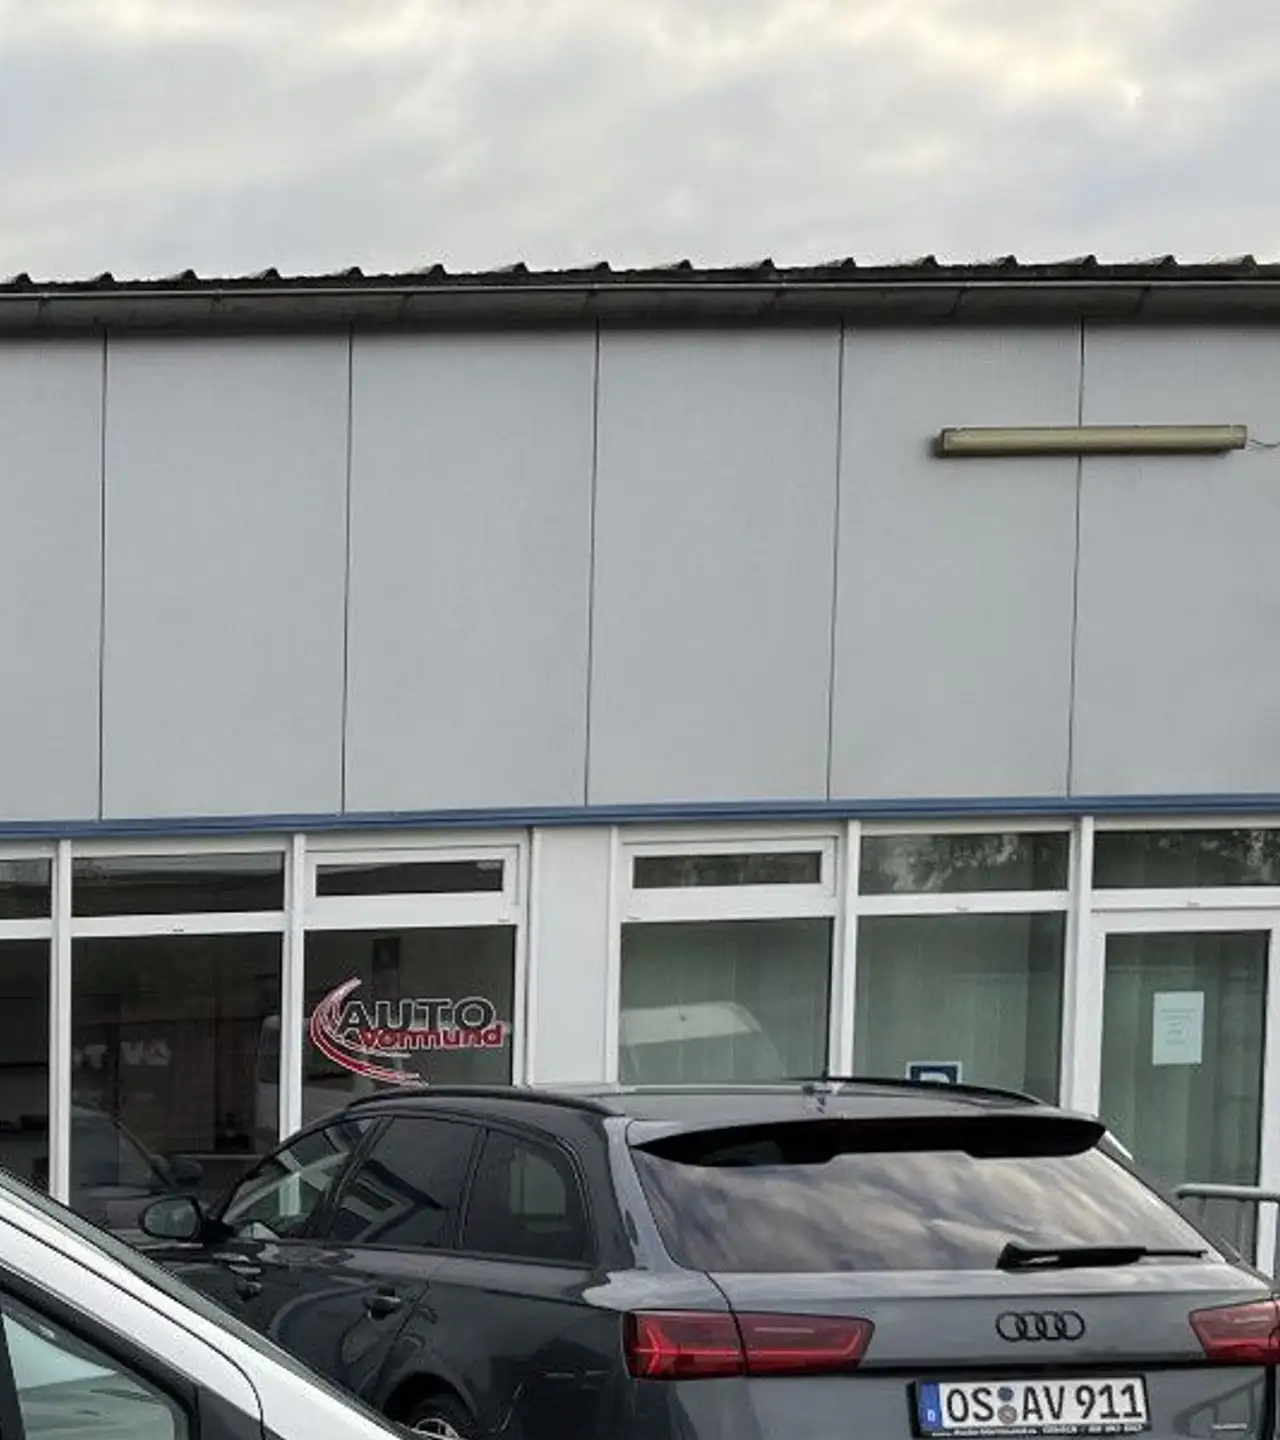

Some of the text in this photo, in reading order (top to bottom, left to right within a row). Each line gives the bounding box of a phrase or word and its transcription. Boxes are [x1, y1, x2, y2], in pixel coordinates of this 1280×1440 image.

[336, 996, 497, 1030] AUTO
[946, 1383, 1143, 1422] OS AV 911
